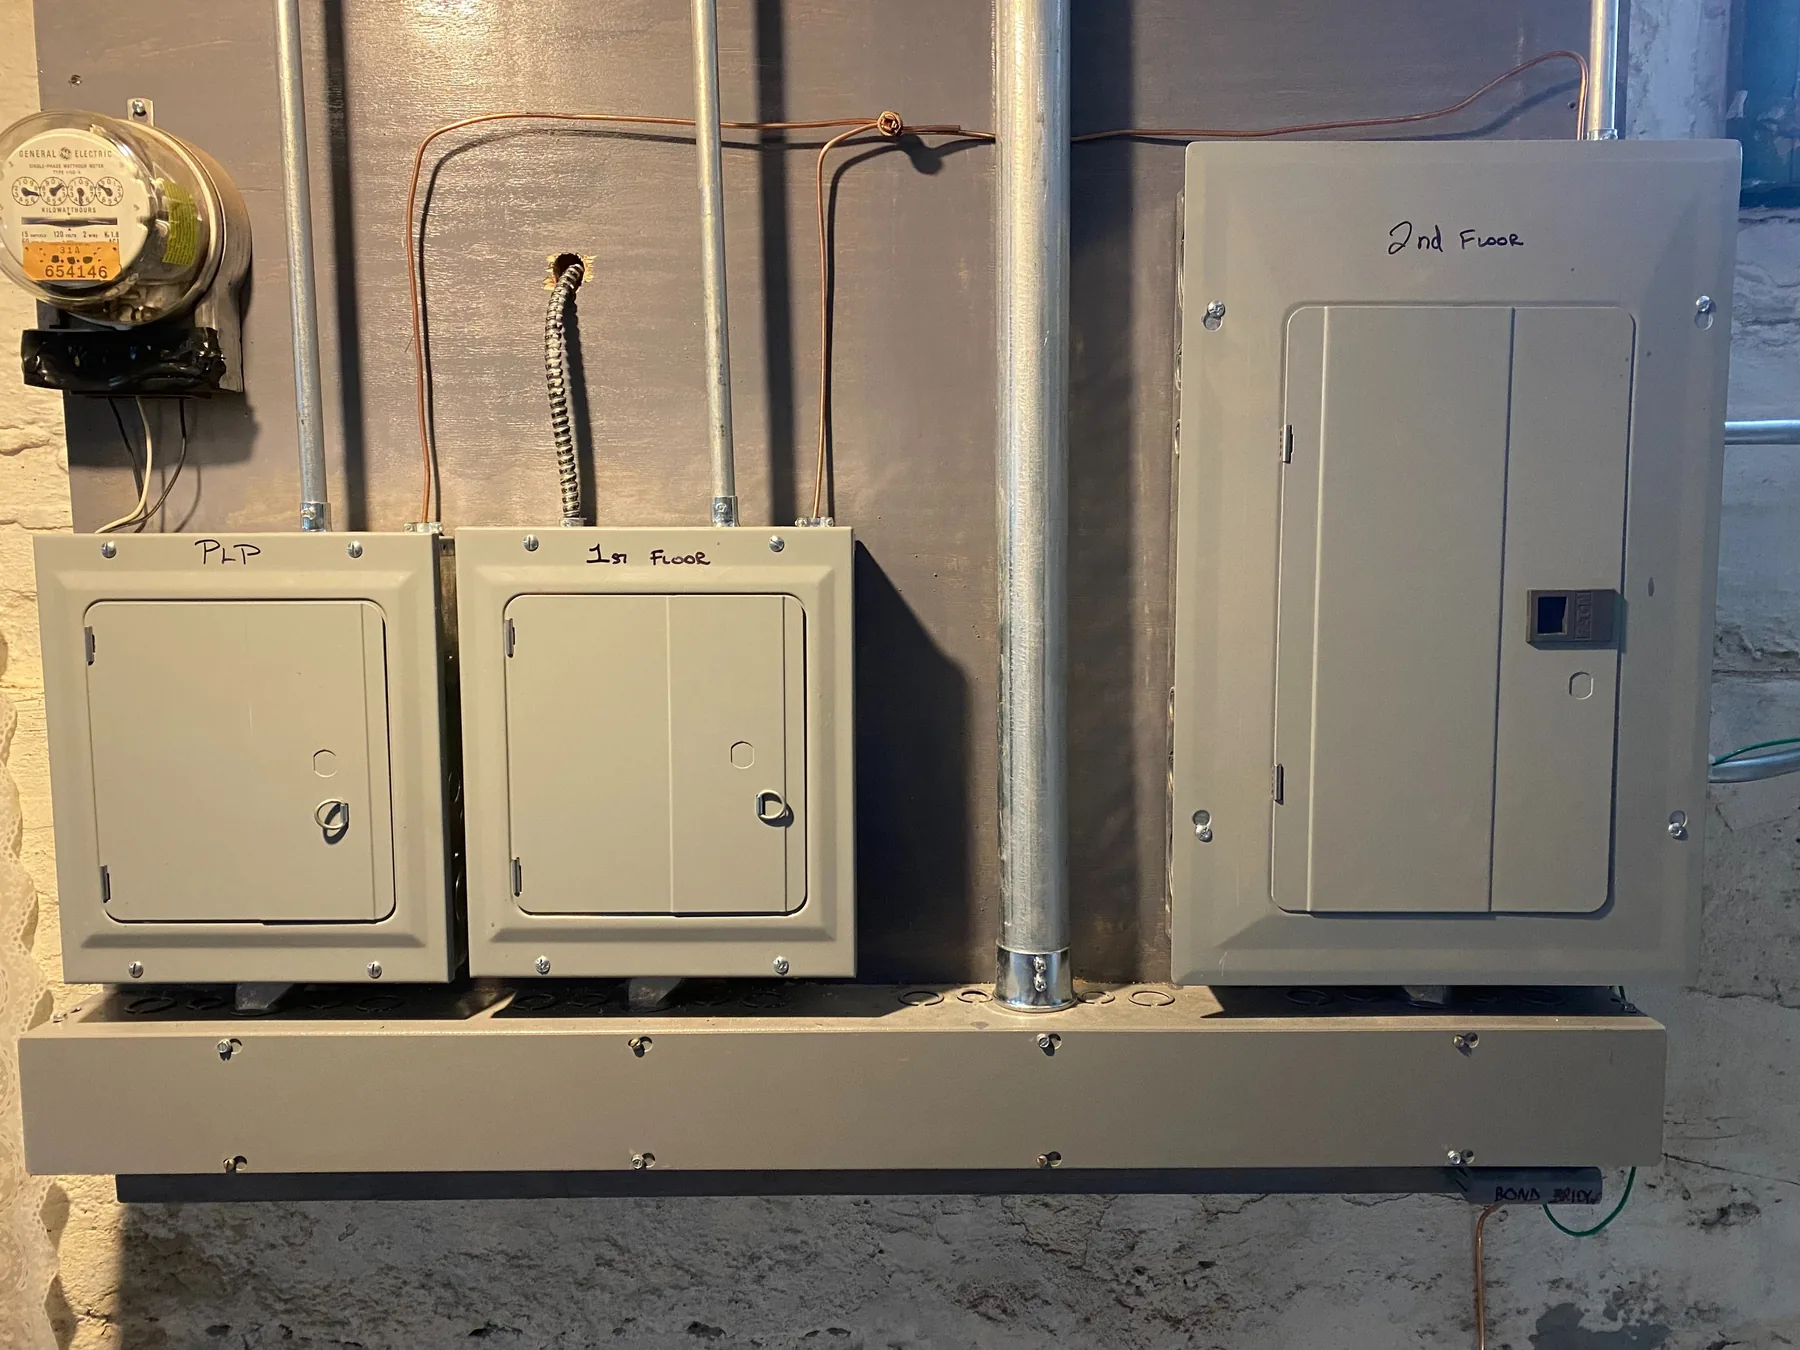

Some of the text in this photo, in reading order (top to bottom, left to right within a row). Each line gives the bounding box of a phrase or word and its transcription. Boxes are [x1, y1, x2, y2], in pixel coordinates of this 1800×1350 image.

[18, 149, 56, 158] GENERAL
[74, 149, 112, 158] ELECTRIC
[1388, 220, 1444, 254] 2nd
[45, 265, 108, 279] 654146
[194, 539, 261, 564] PLP
[1494, 1186, 1541, 1202] BOND
